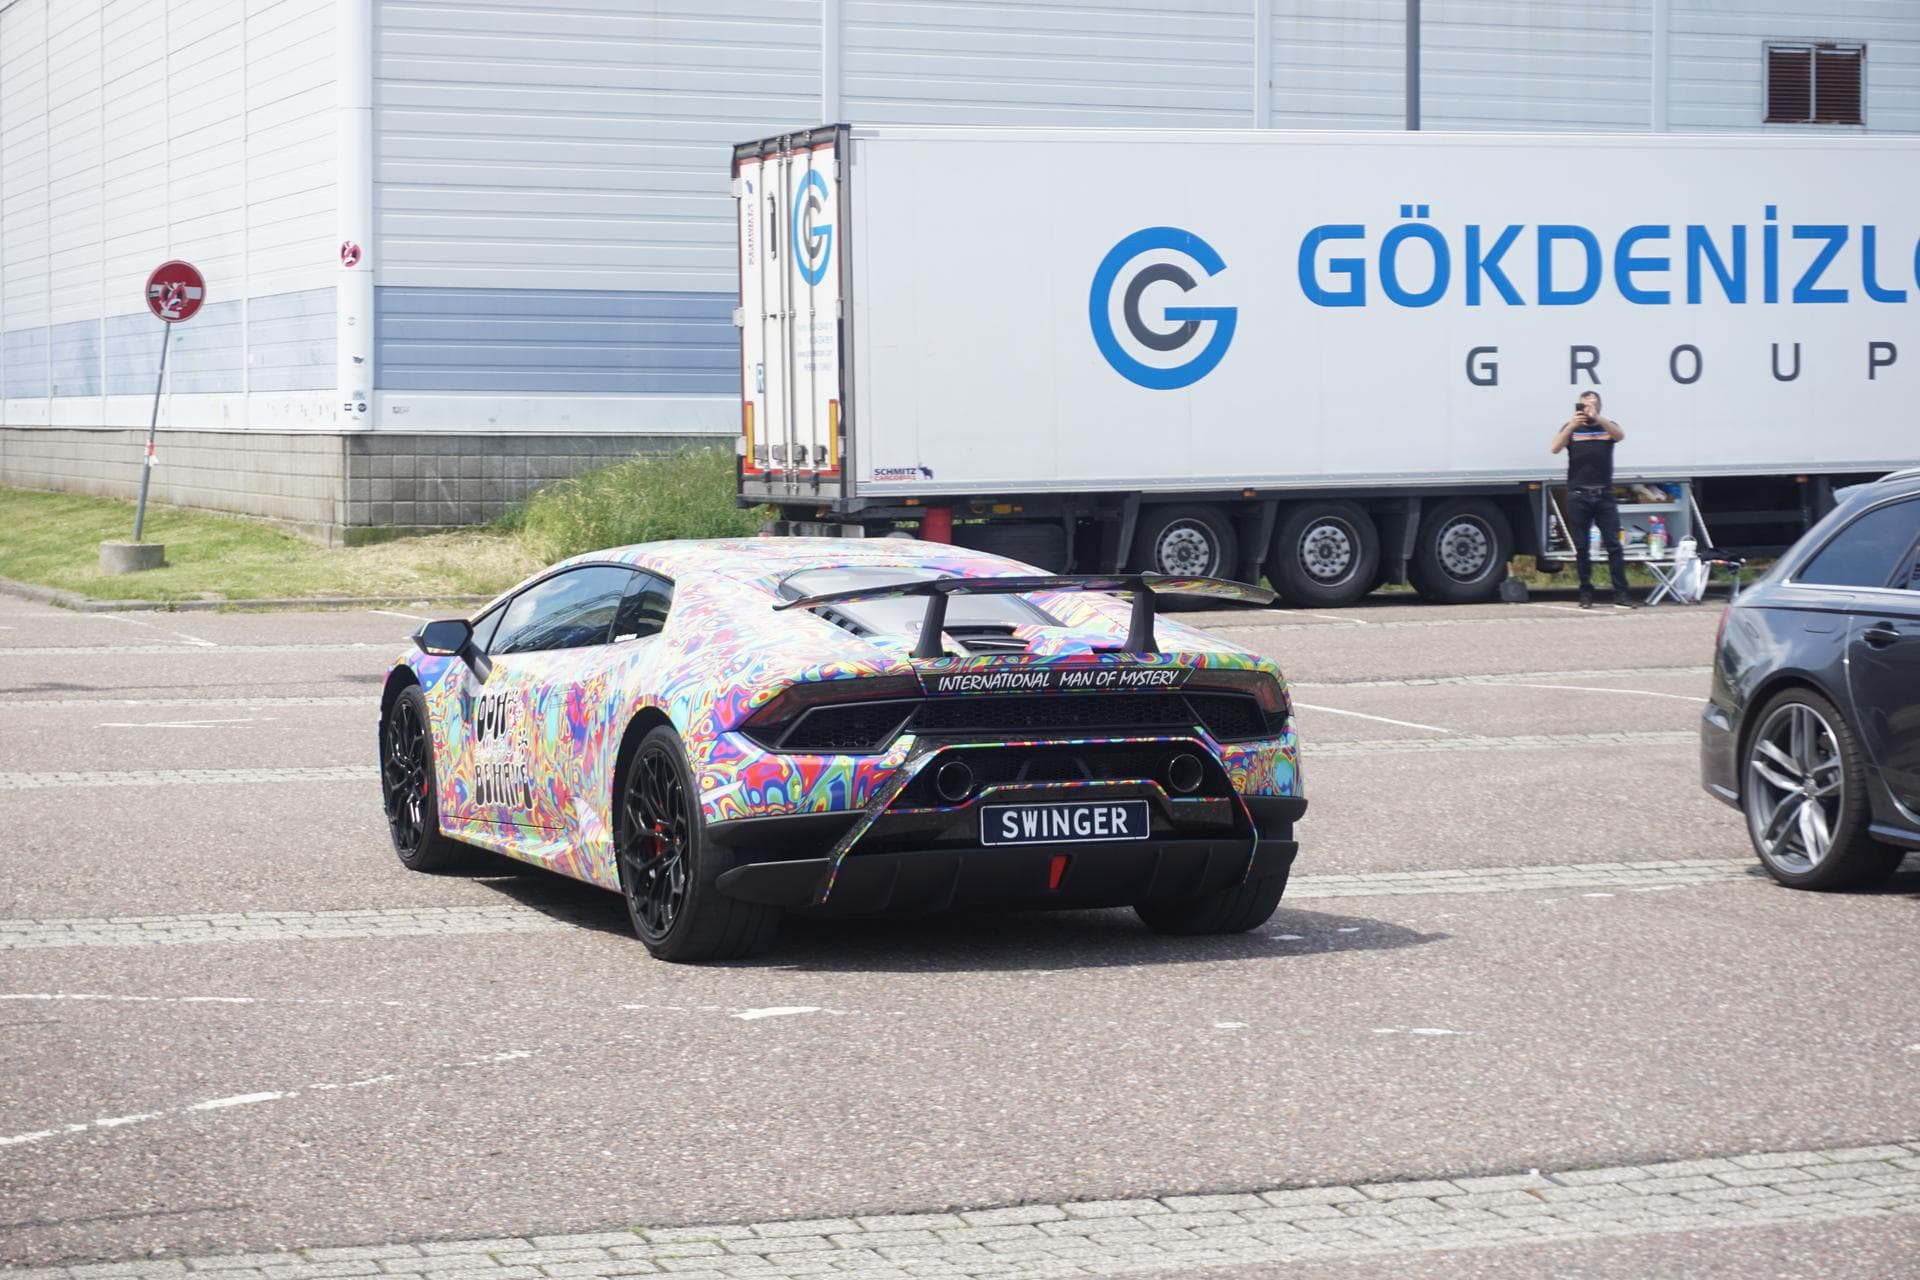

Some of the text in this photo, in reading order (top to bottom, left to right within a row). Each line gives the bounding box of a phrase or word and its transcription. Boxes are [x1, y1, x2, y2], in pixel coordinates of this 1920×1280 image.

[1466, 341, 1898, 387] GROUP
[938, 670, 1178, 692] INTERNATIONAL MAN OF MYSTERY
[475, 762, 534, 810] BEHAVE
[1002, 807, 1129, 839] SWINGER
